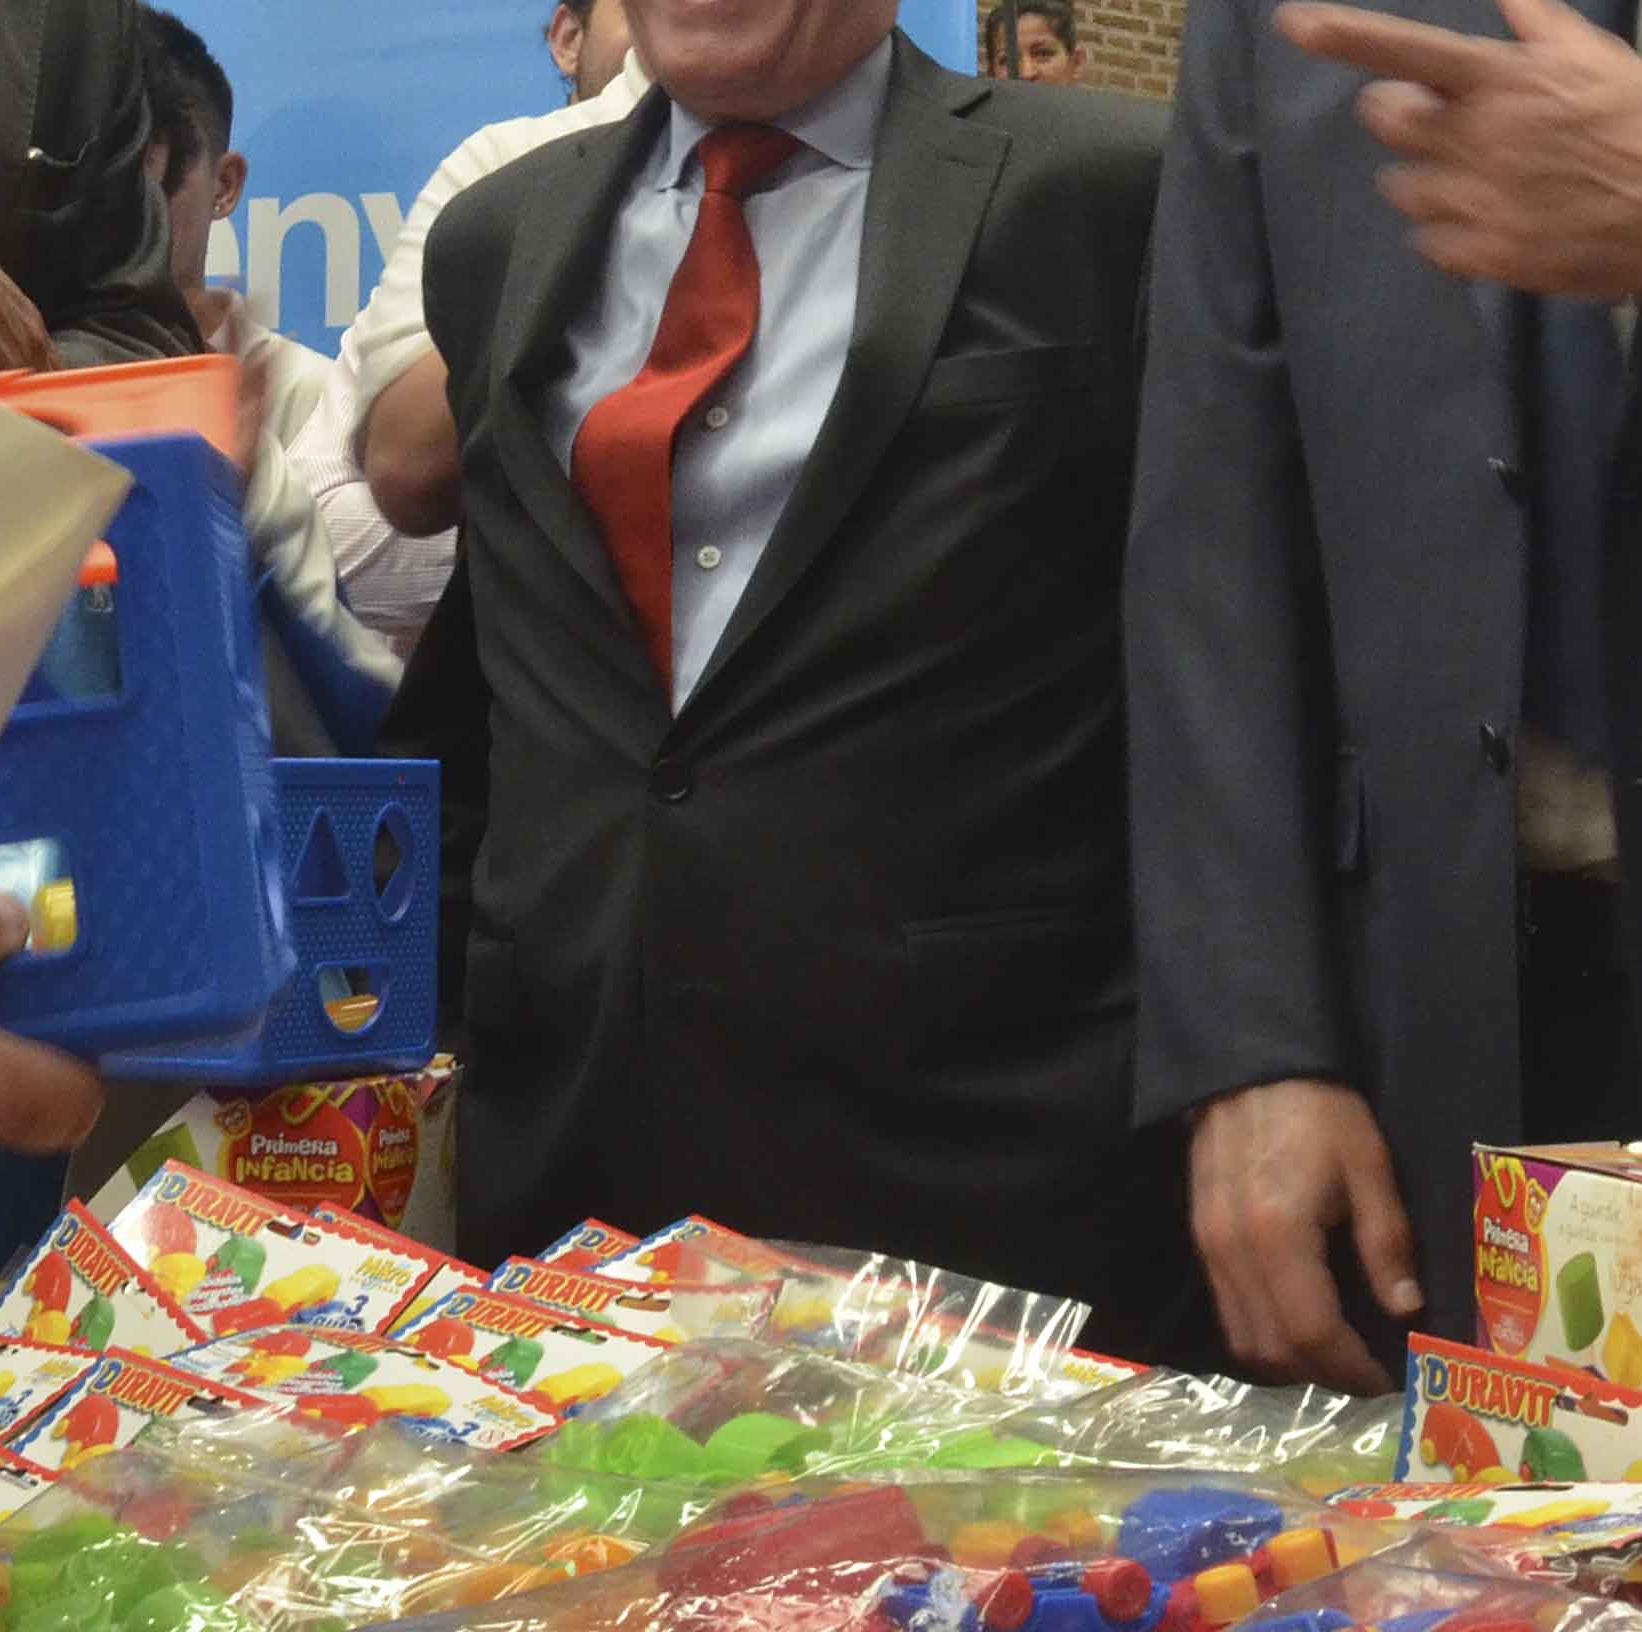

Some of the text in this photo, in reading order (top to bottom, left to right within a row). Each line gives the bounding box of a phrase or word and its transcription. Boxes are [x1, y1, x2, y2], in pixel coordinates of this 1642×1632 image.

[156, 1171, 278, 1238] DURAVIT
[53, 1216, 131, 1297] DURAVIT
[344, 1295, 369, 1316] 3
[442, 1293, 562, 1339] DURAVIT
[500, 1263, 622, 1314] DURAVIT
[89, 1356, 199, 1418] DURAVIT
[1420, 1352, 1562, 1430] DURAVIT
